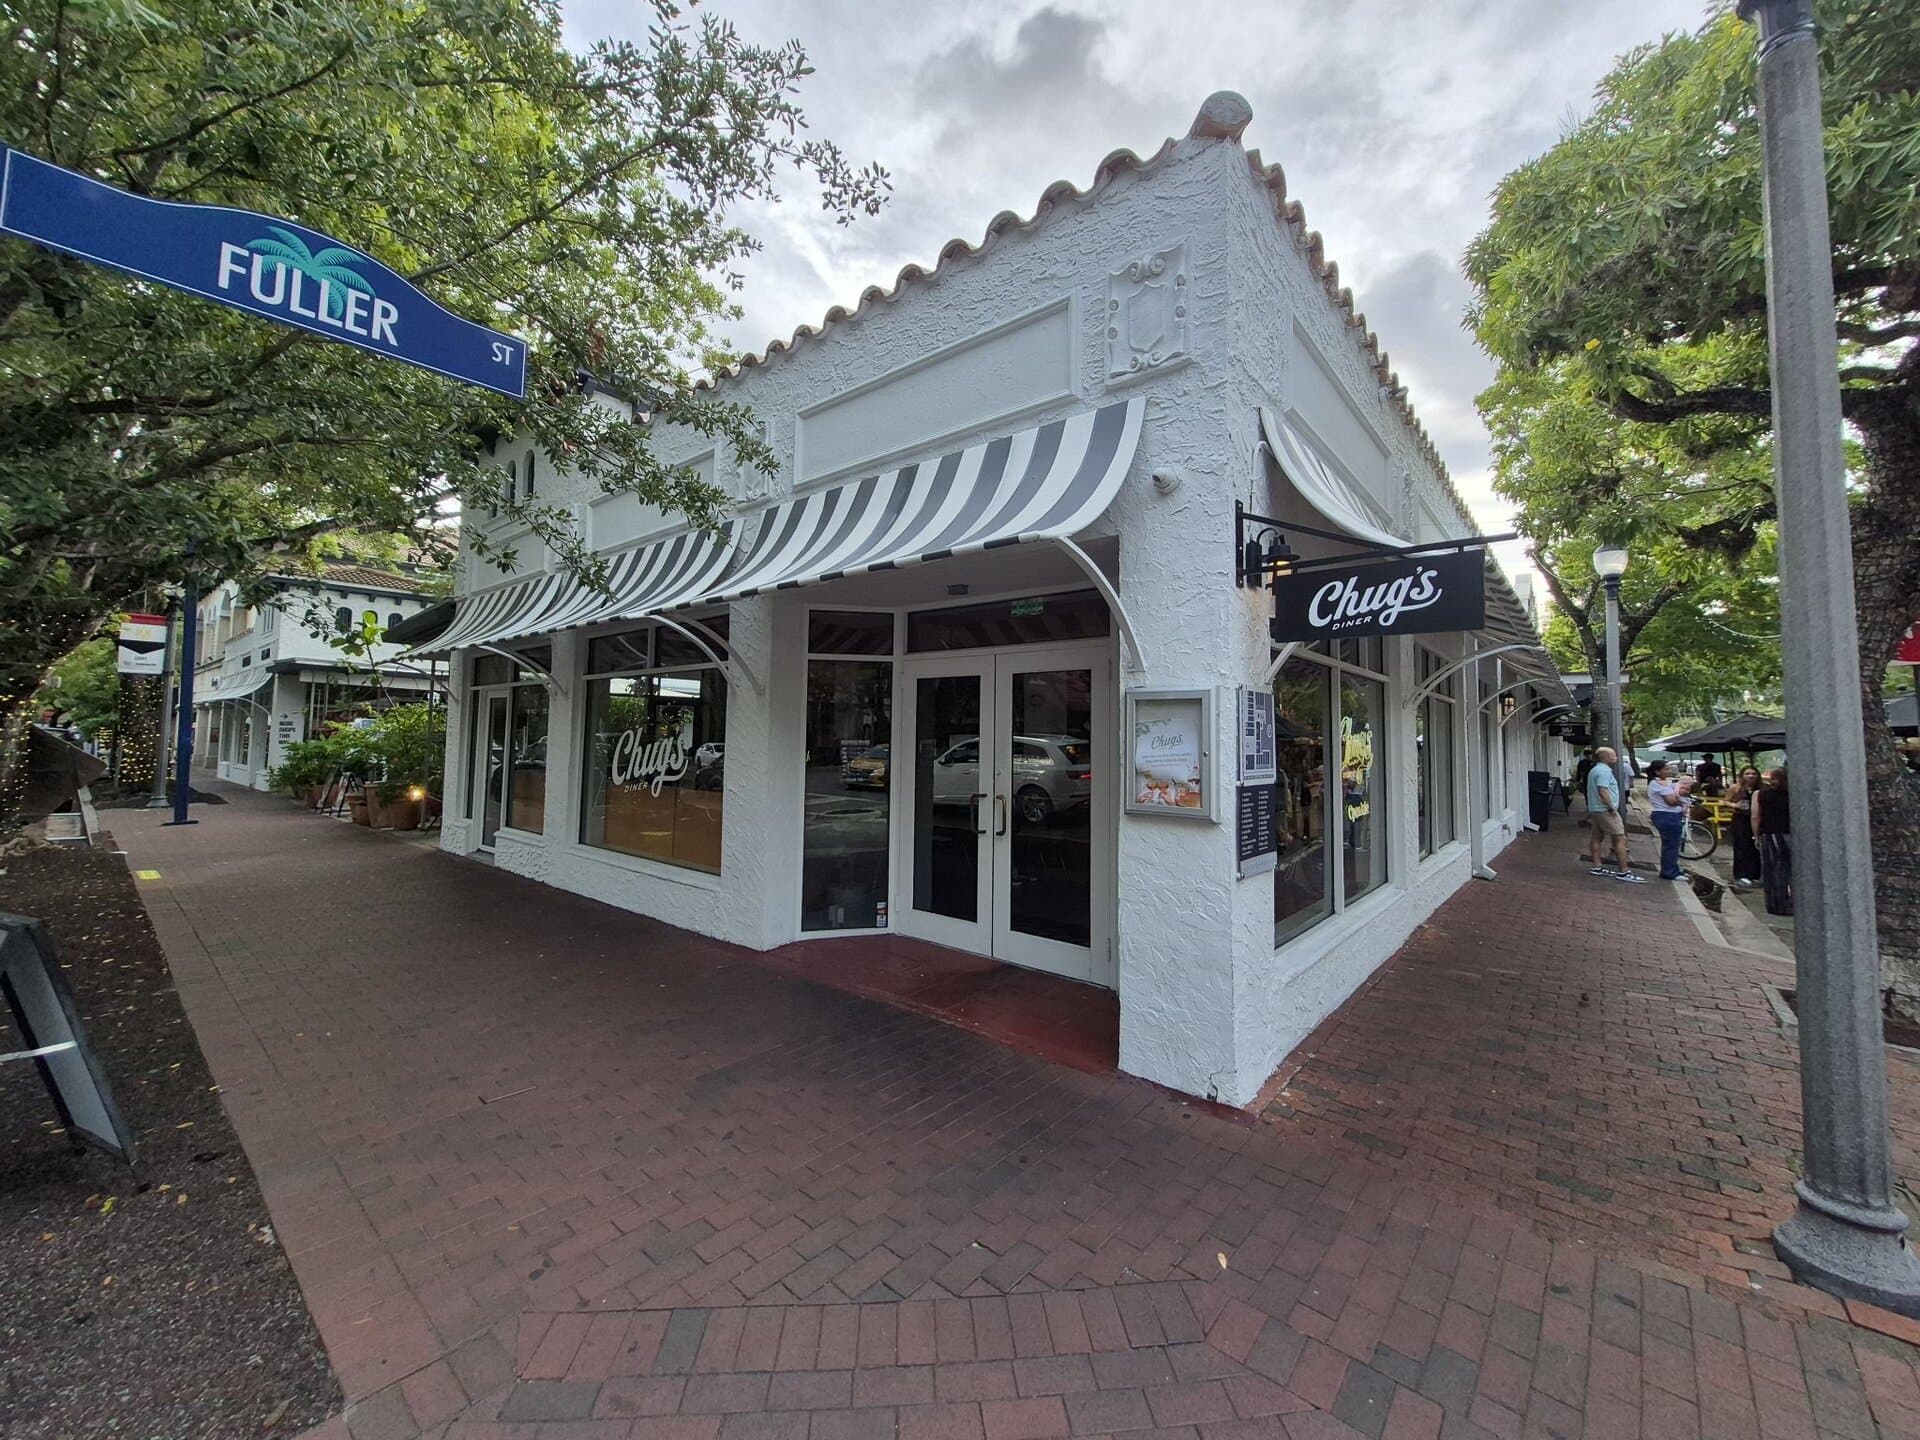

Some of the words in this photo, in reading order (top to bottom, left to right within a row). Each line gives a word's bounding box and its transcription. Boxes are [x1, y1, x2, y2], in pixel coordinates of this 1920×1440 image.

[217, 241, 399, 346] FULLER
[491, 341, 515, 366] ST
[1308, 565, 1443, 627] Chug's
[1332, 615, 1373, 631] DINER
[624, 781, 649, 793] DINER
